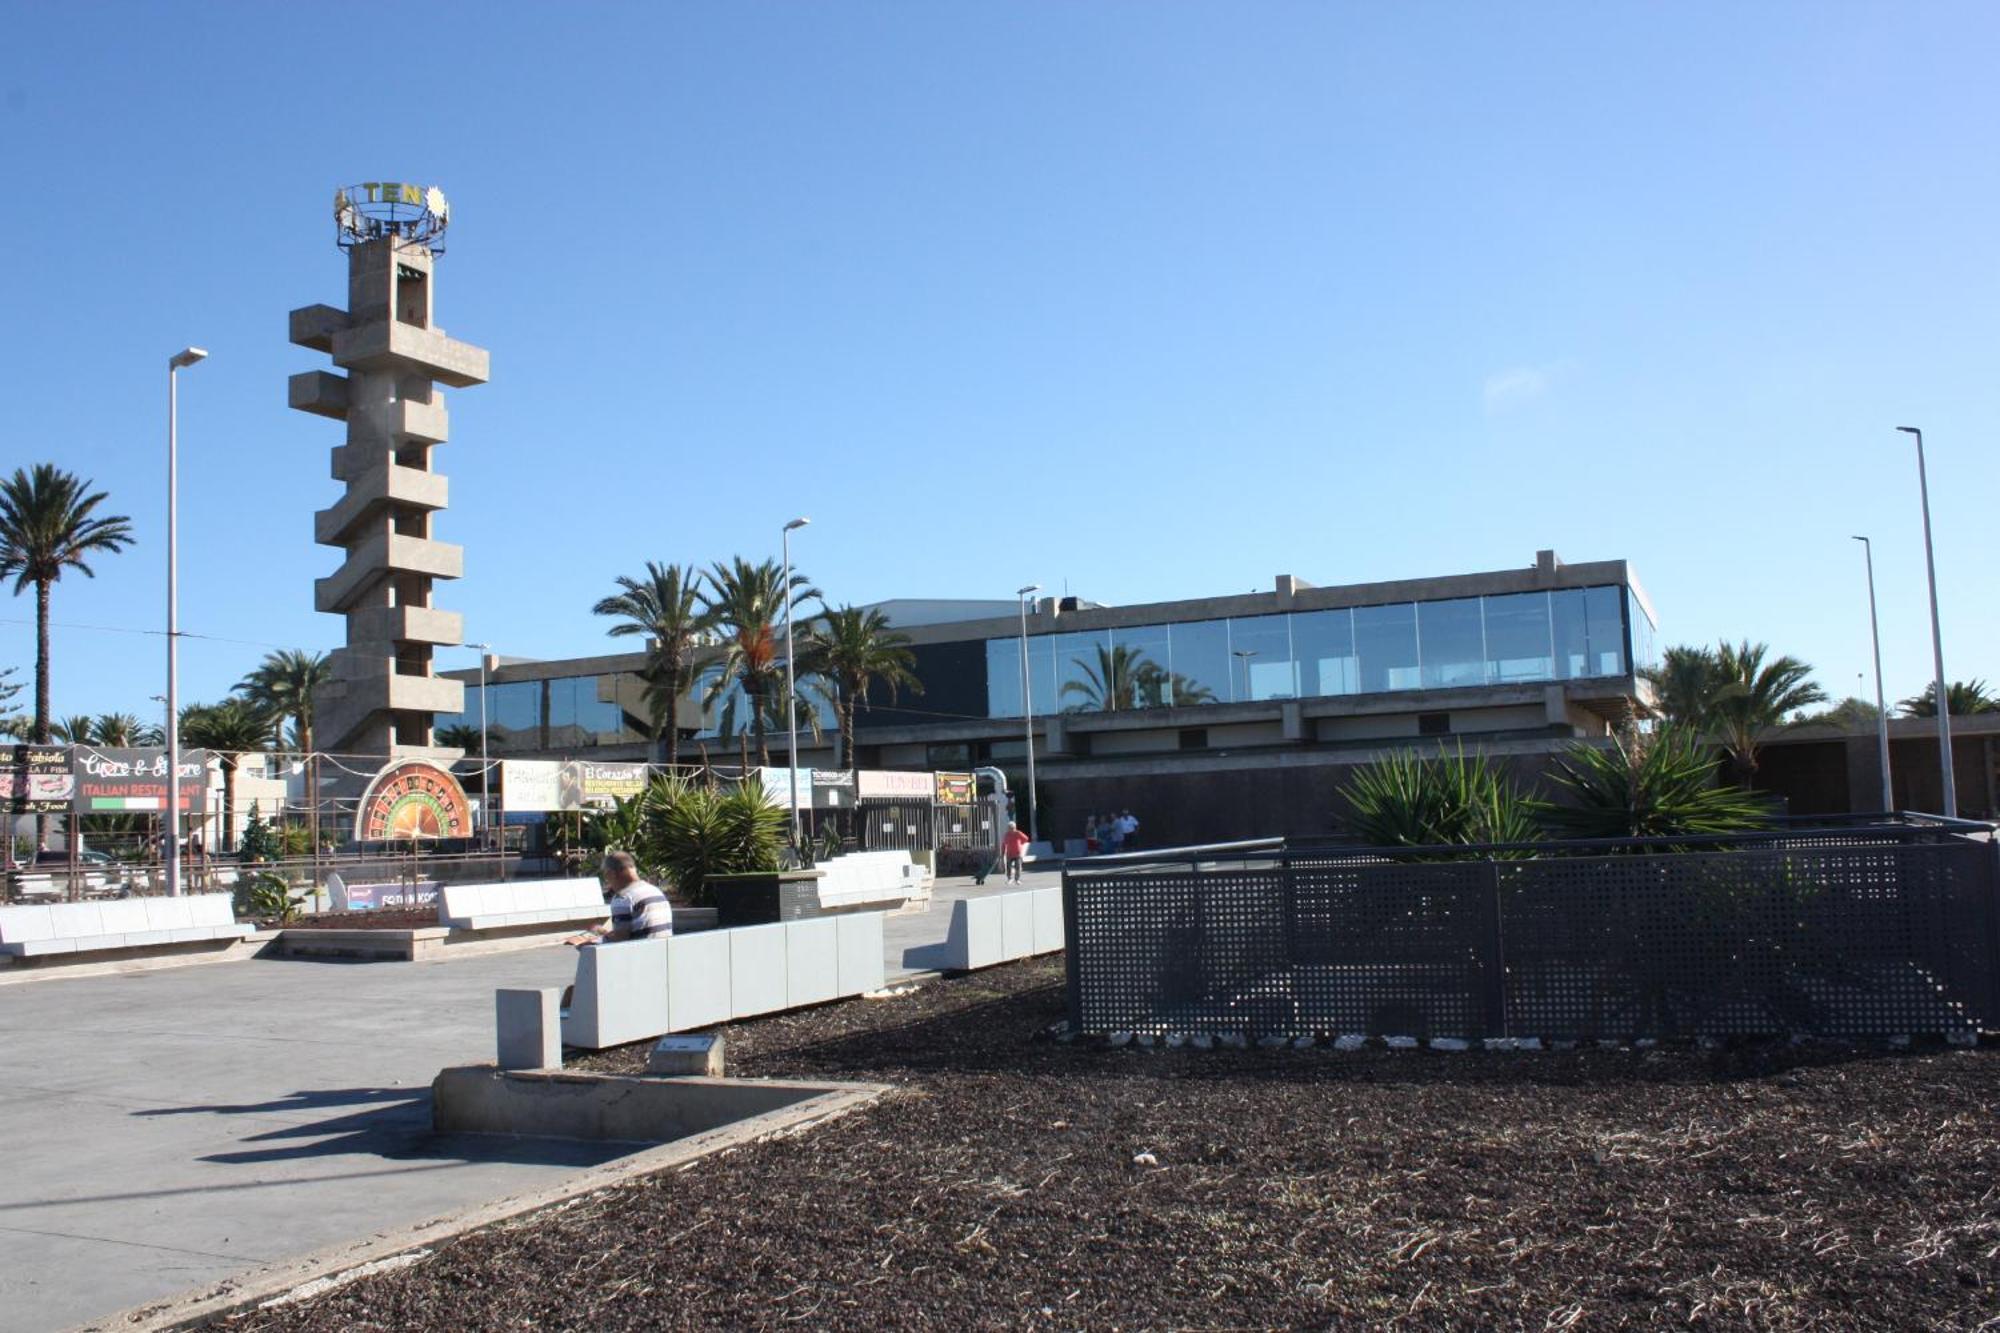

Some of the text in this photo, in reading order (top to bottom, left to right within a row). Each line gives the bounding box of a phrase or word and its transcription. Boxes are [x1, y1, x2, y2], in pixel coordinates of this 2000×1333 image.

[363, 182, 421, 206] TEN
[27, 751, 65, 763] Fabiola
[585, 767, 594, 779] El
[82, 783, 201, 797] ITALIAN RESTAUANT
